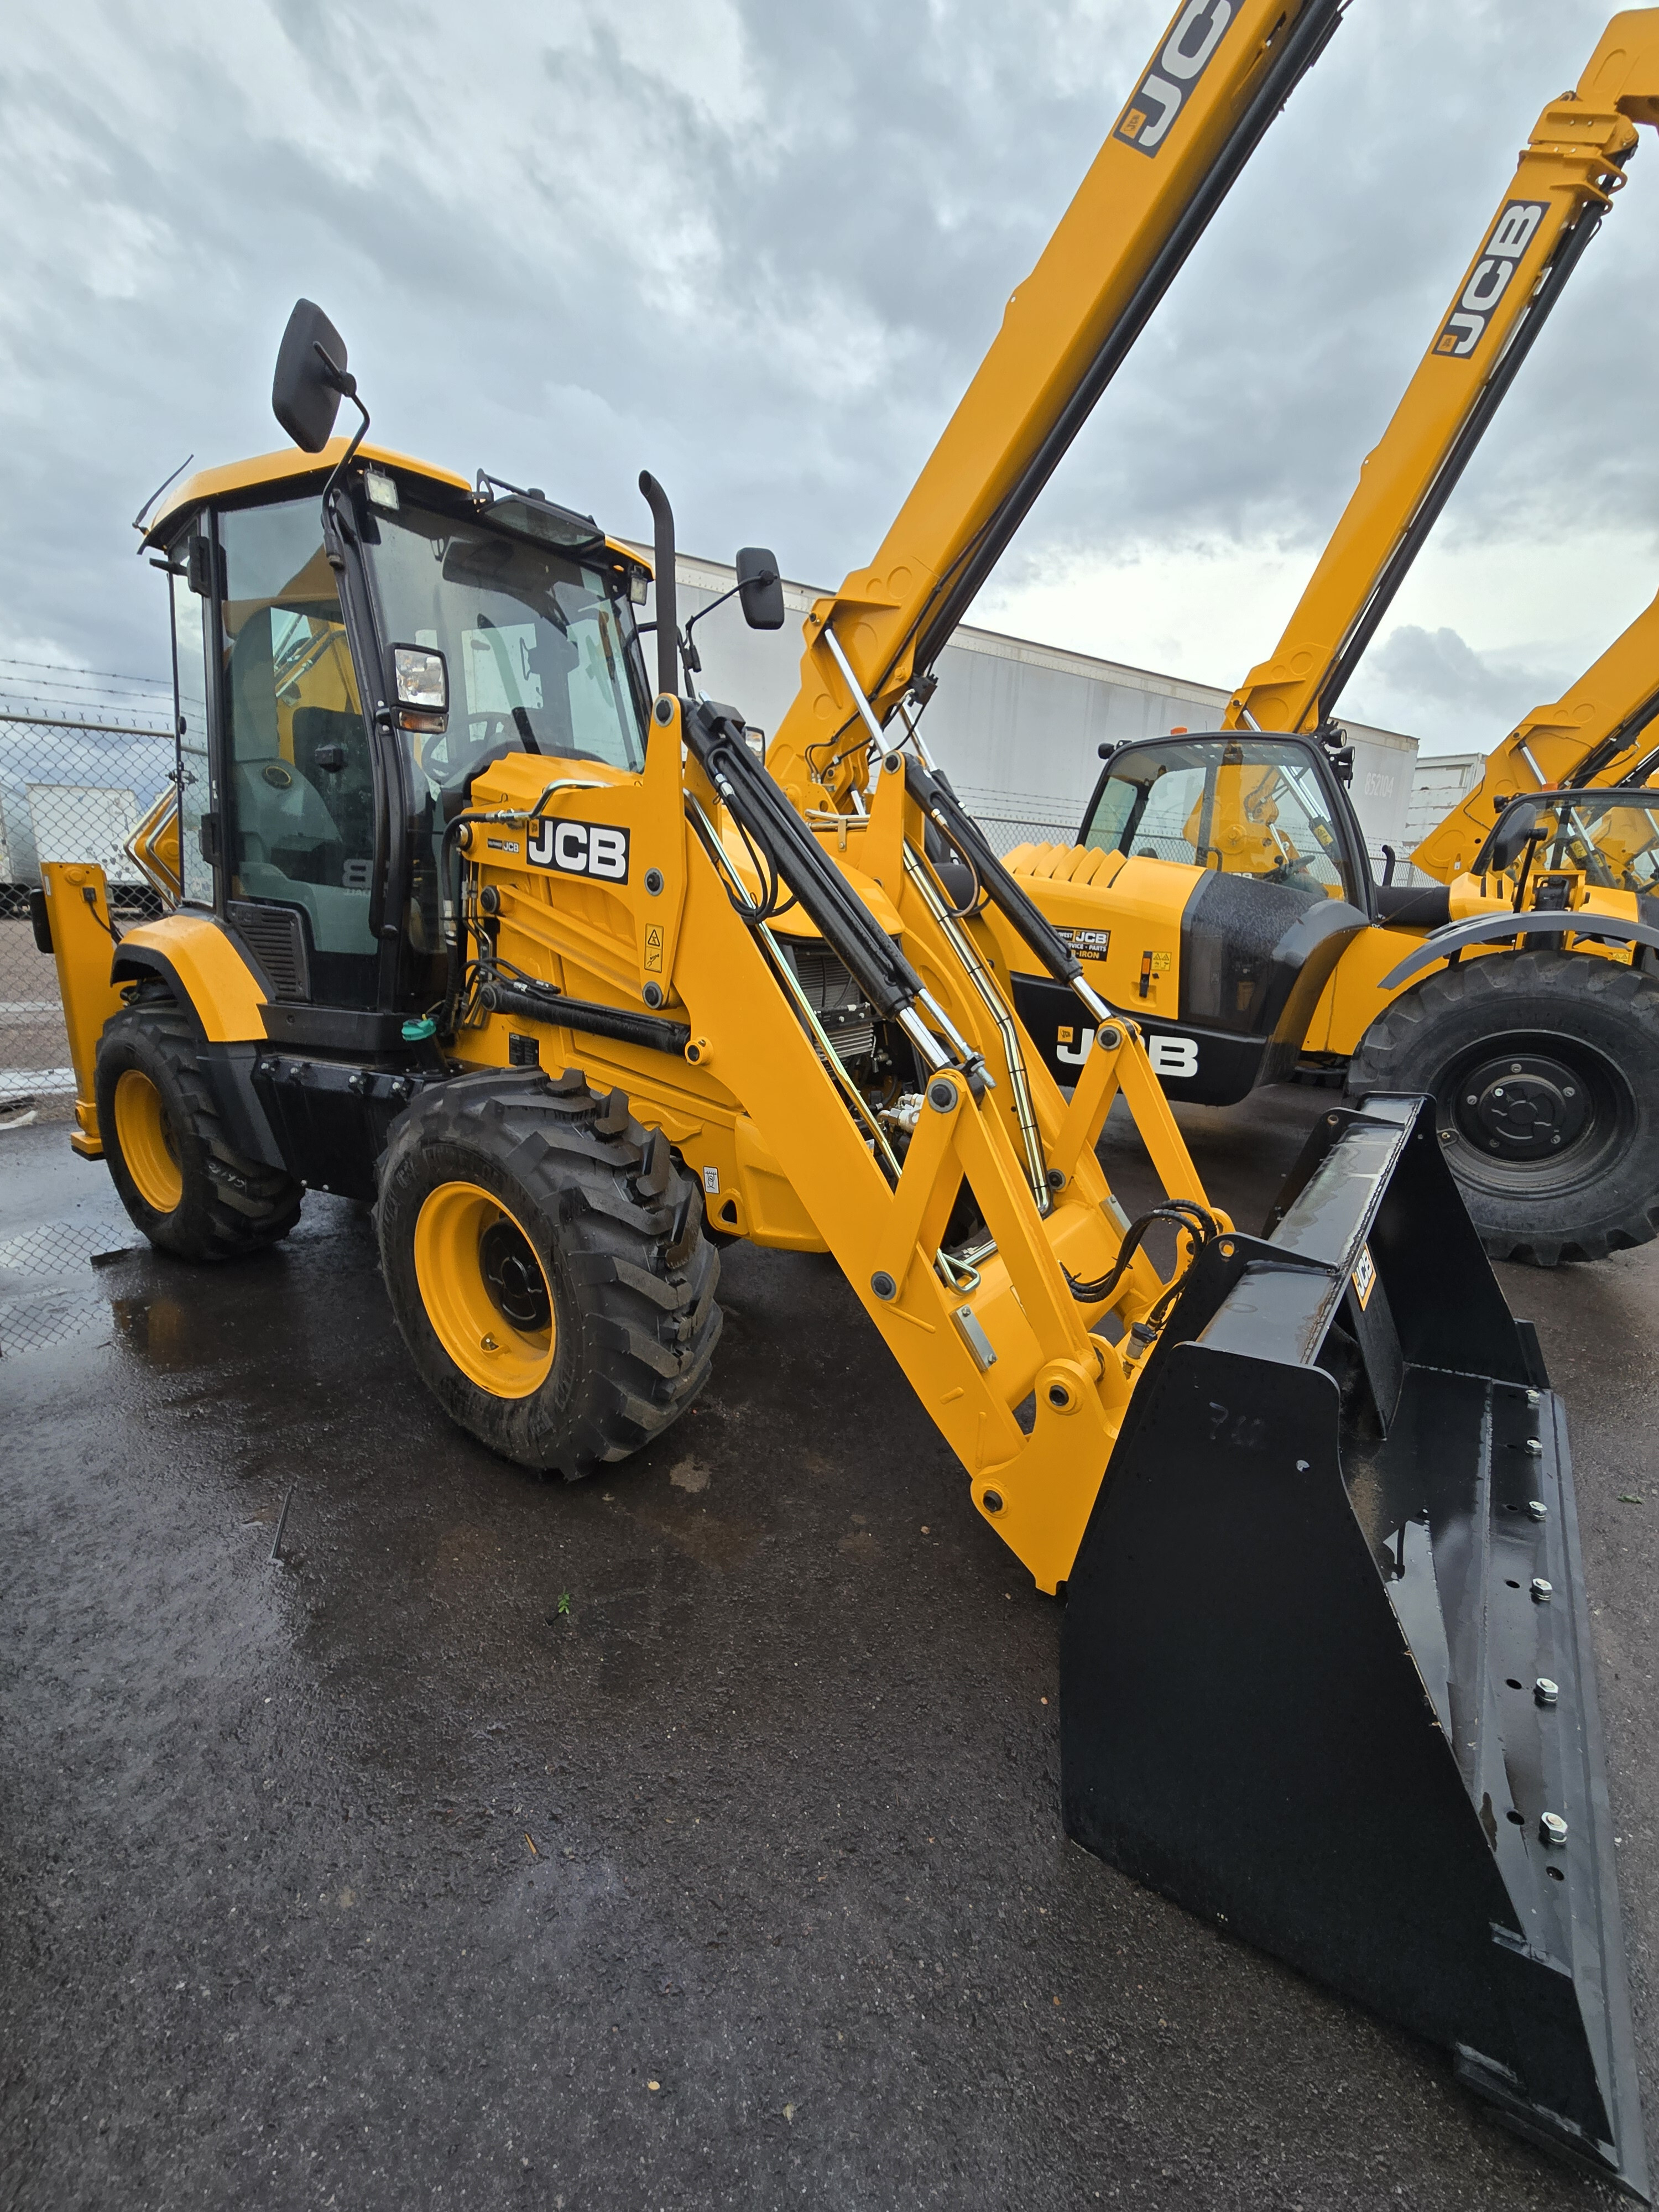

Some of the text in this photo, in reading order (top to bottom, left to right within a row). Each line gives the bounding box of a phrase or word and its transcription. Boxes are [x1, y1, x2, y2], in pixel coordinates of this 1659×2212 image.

[1138, 0, 1231, 147] JC
[1449, 205, 1542, 354] JCB
[1364, 772, 1394, 798] 852104
[504, 842, 519, 852] JCB
[529, 820, 626, 878] JCB
[1076, 932, 1107, 944] JCB
[1057, 1029, 1198, 1077] JB
[1356, 1249, 1373, 1297] JCB
